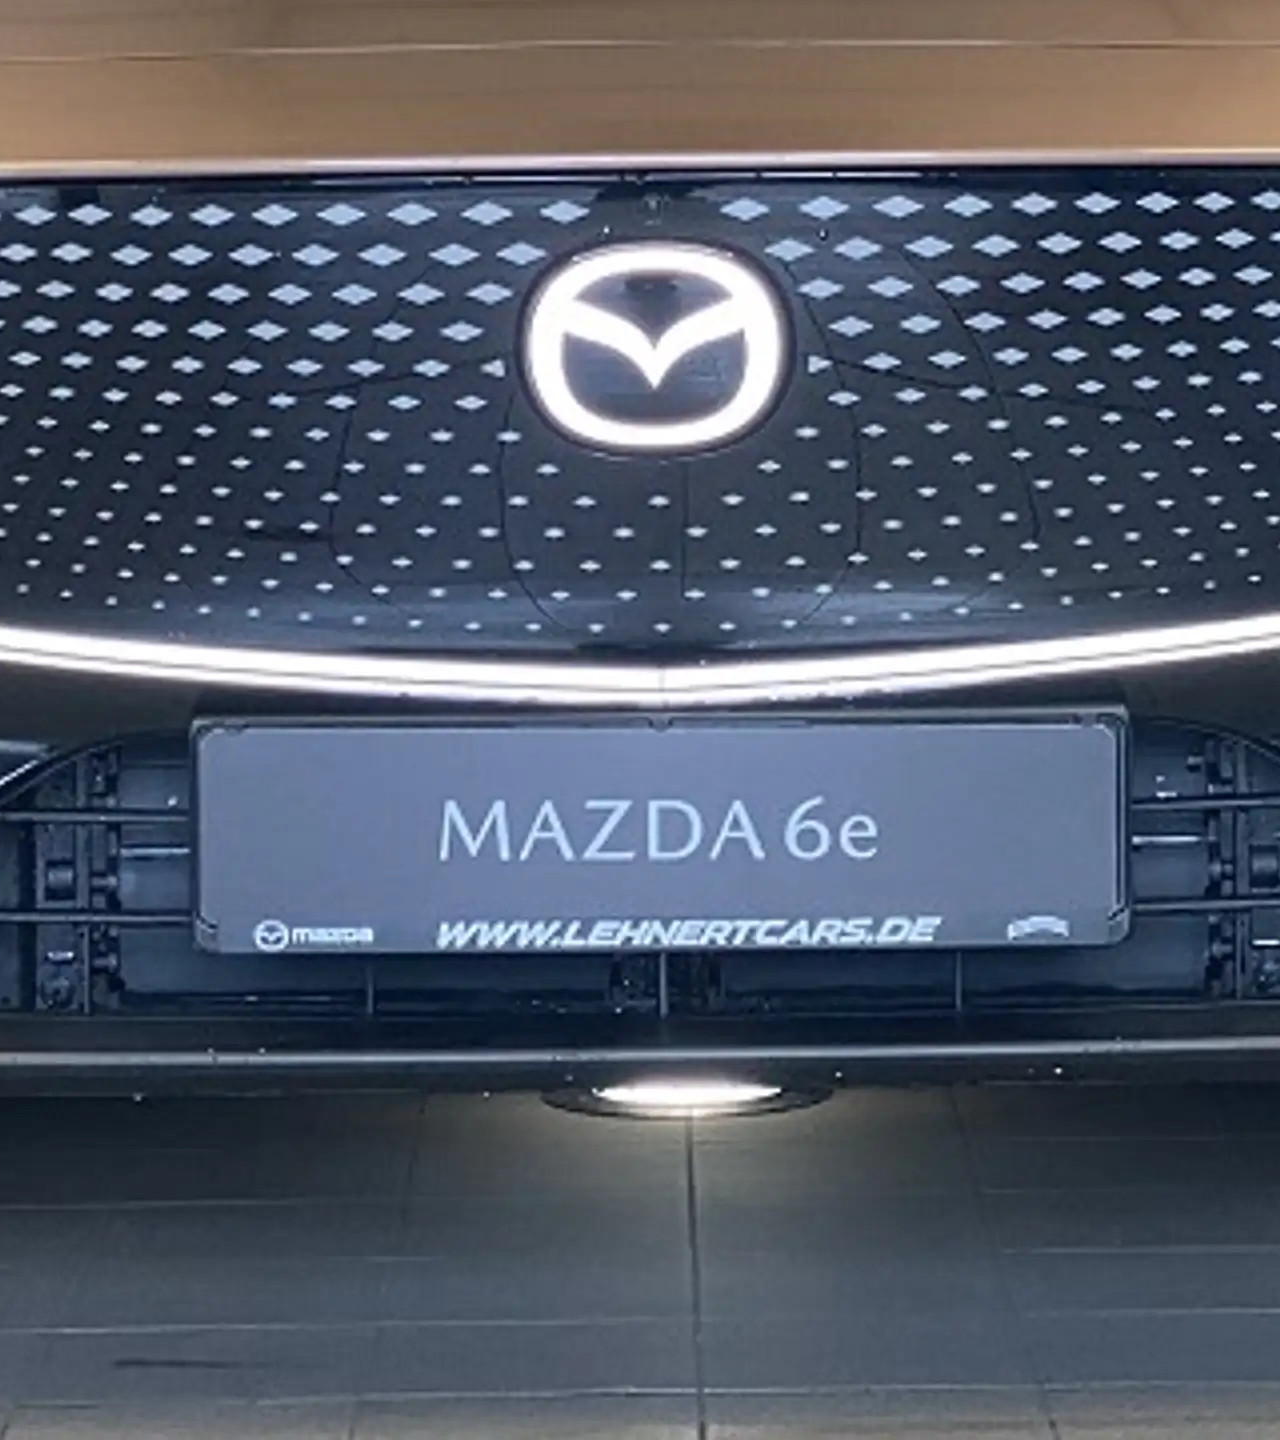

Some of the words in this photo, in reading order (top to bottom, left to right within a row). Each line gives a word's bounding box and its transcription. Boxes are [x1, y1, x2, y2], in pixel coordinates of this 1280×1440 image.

[439, 799, 766, 861] MAZDA
[783, 796, 879, 861] 6e
[436, 916, 942, 948] WWW.LEHNERTCARS.DE
